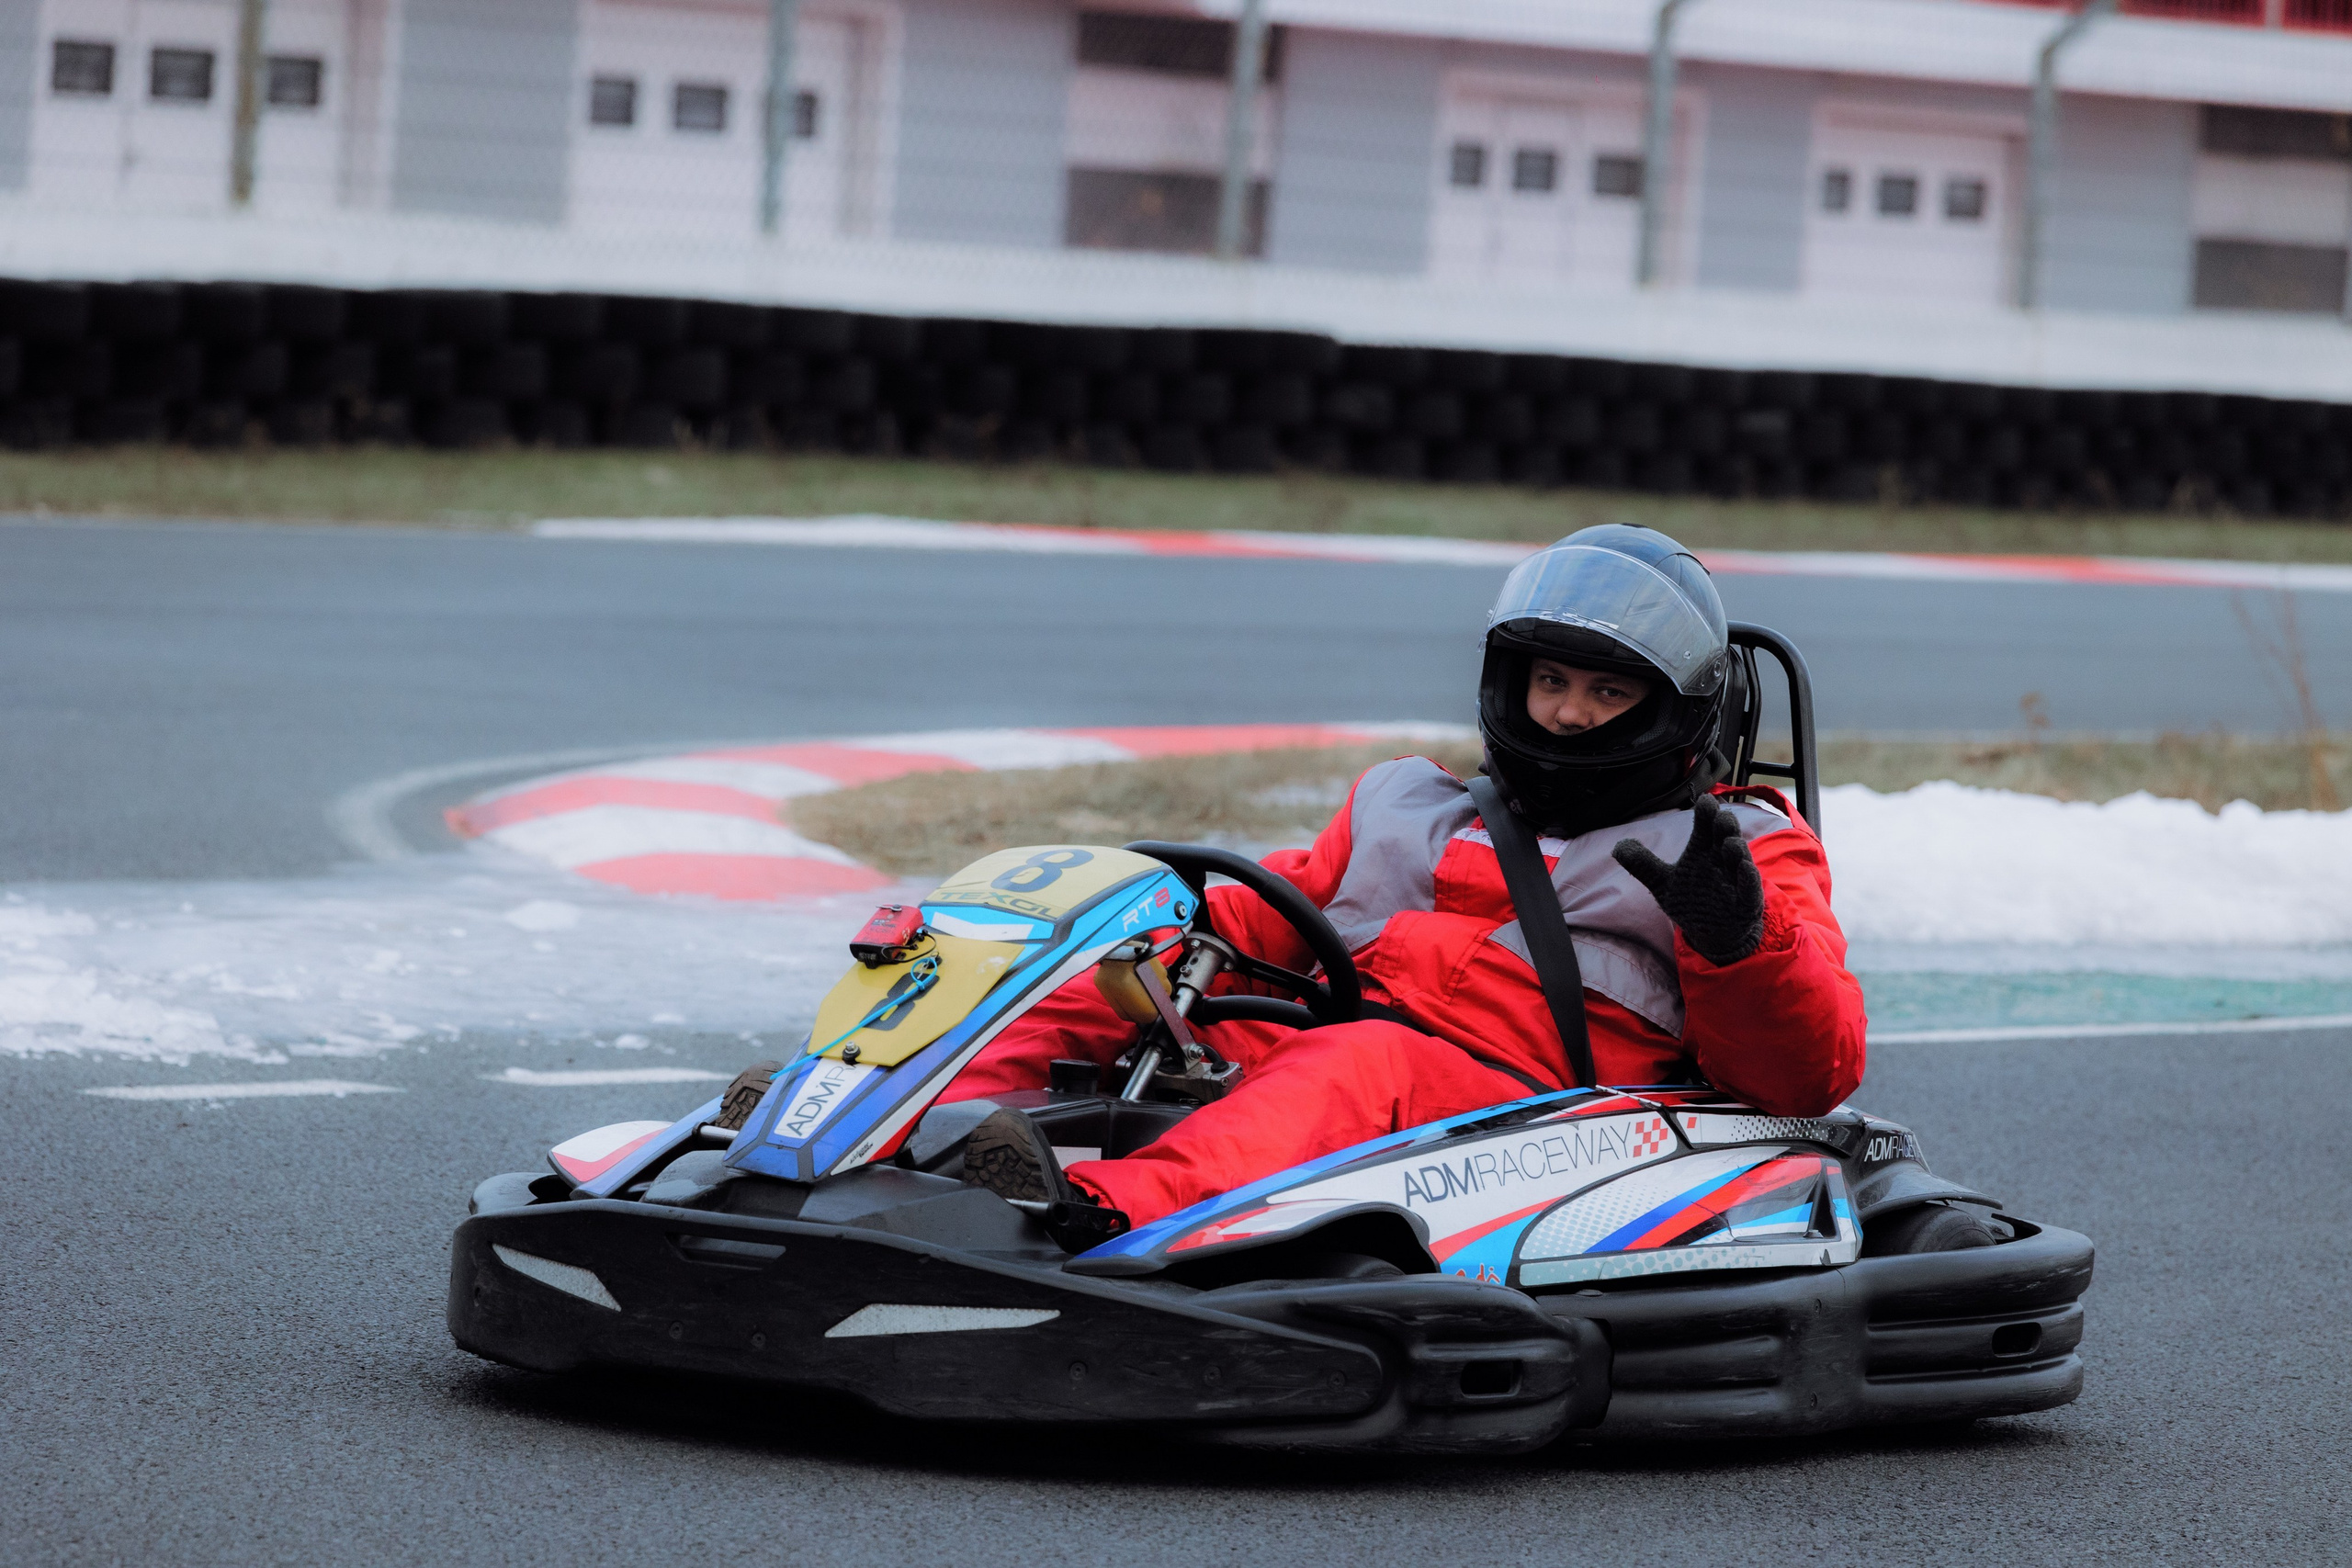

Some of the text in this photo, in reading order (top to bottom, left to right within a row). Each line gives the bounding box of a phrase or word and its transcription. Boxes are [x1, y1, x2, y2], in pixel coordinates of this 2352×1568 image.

[990, 849, 1094, 893] 8
[1122, 886, 1170, 932] RT8
[1402, 1122, 1631, 1208] ADMRACEWAY
